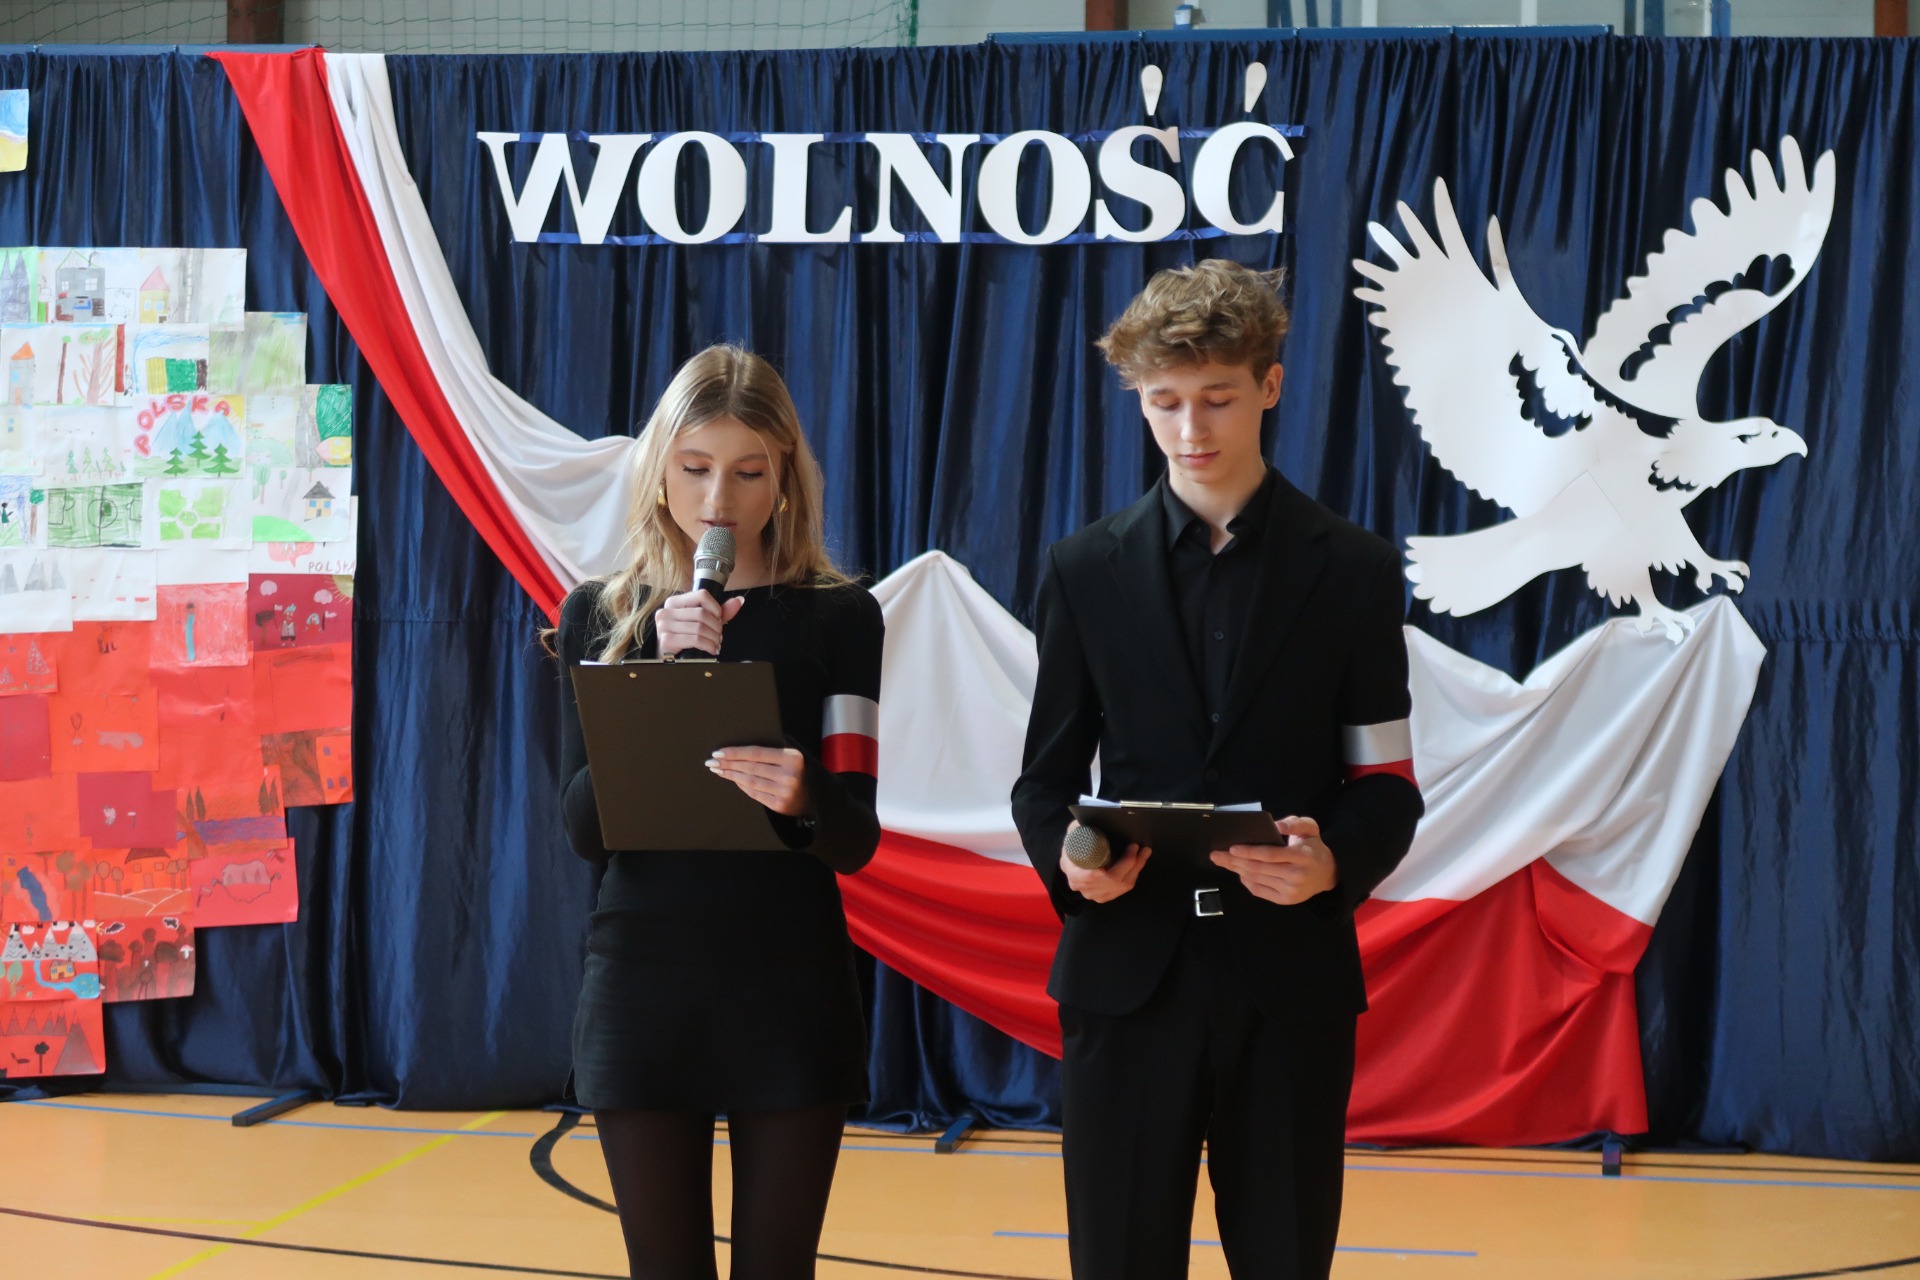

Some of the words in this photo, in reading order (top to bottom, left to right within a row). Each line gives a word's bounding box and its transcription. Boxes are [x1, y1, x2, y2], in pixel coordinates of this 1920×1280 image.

[476, 61, 1295, 245] WOLNOŚĆ
[134, 394, 231, 457] POLSKA
[308, 560, 356, 573] POLSKA
